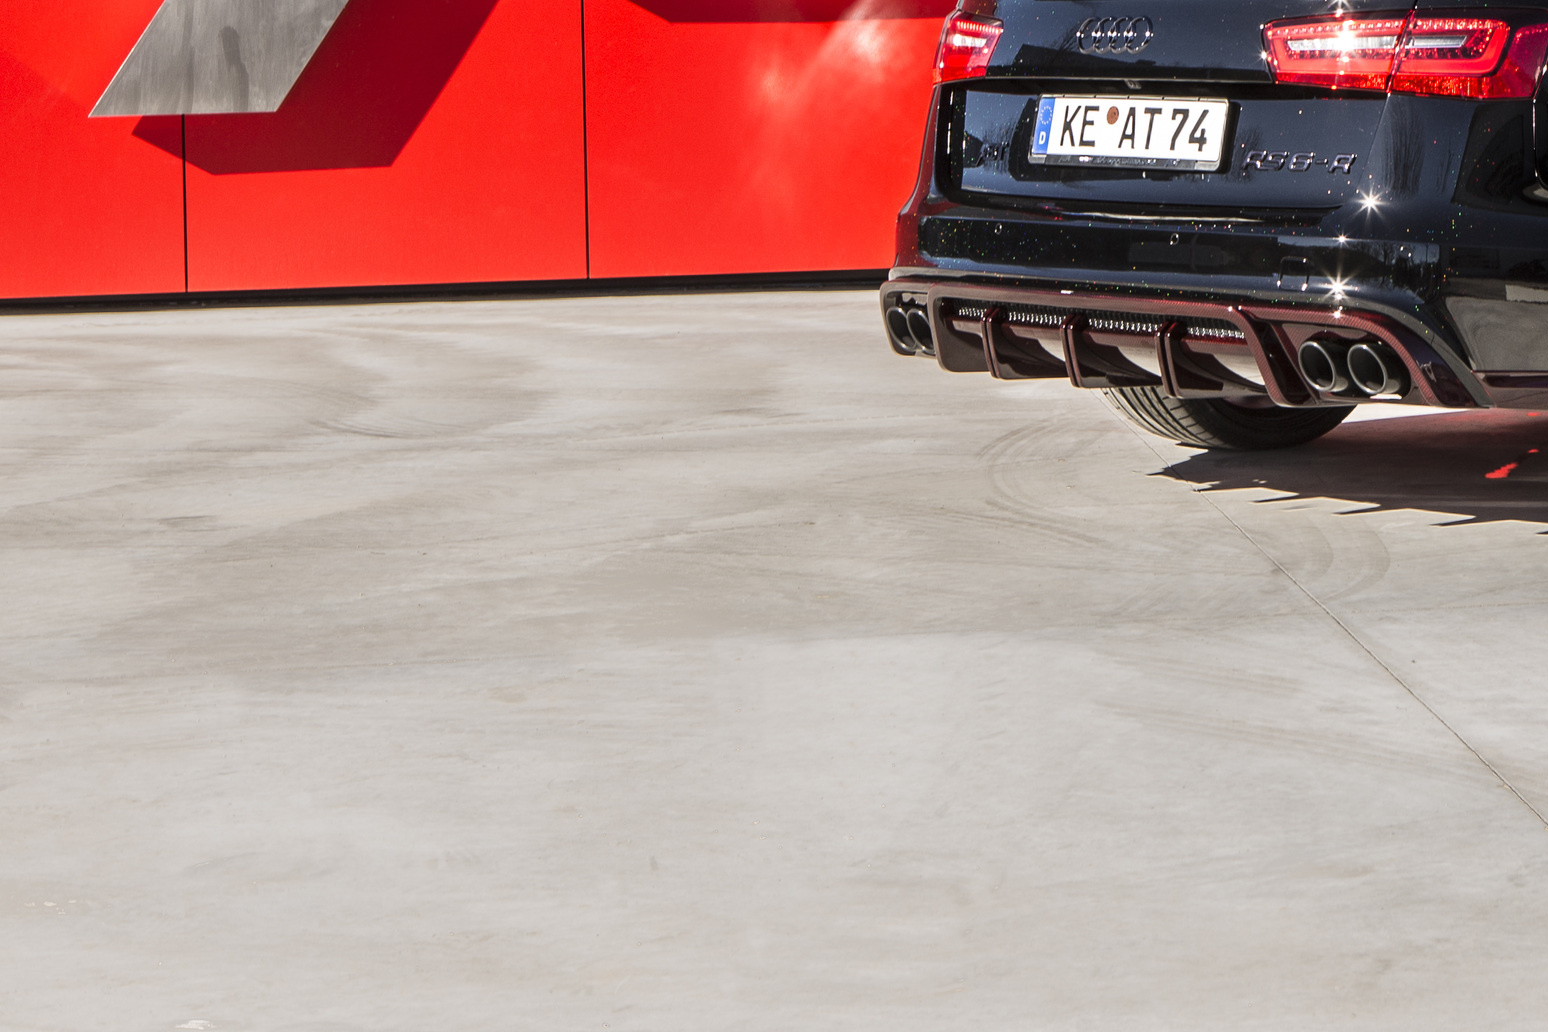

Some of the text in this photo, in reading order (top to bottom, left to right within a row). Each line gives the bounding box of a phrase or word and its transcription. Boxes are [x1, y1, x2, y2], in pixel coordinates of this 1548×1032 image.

[1038, 130, 1047, 145] D
[1060, 105, 1210, 152] KE AT 74
[1240, 150, 1358, 174] RS6-R
